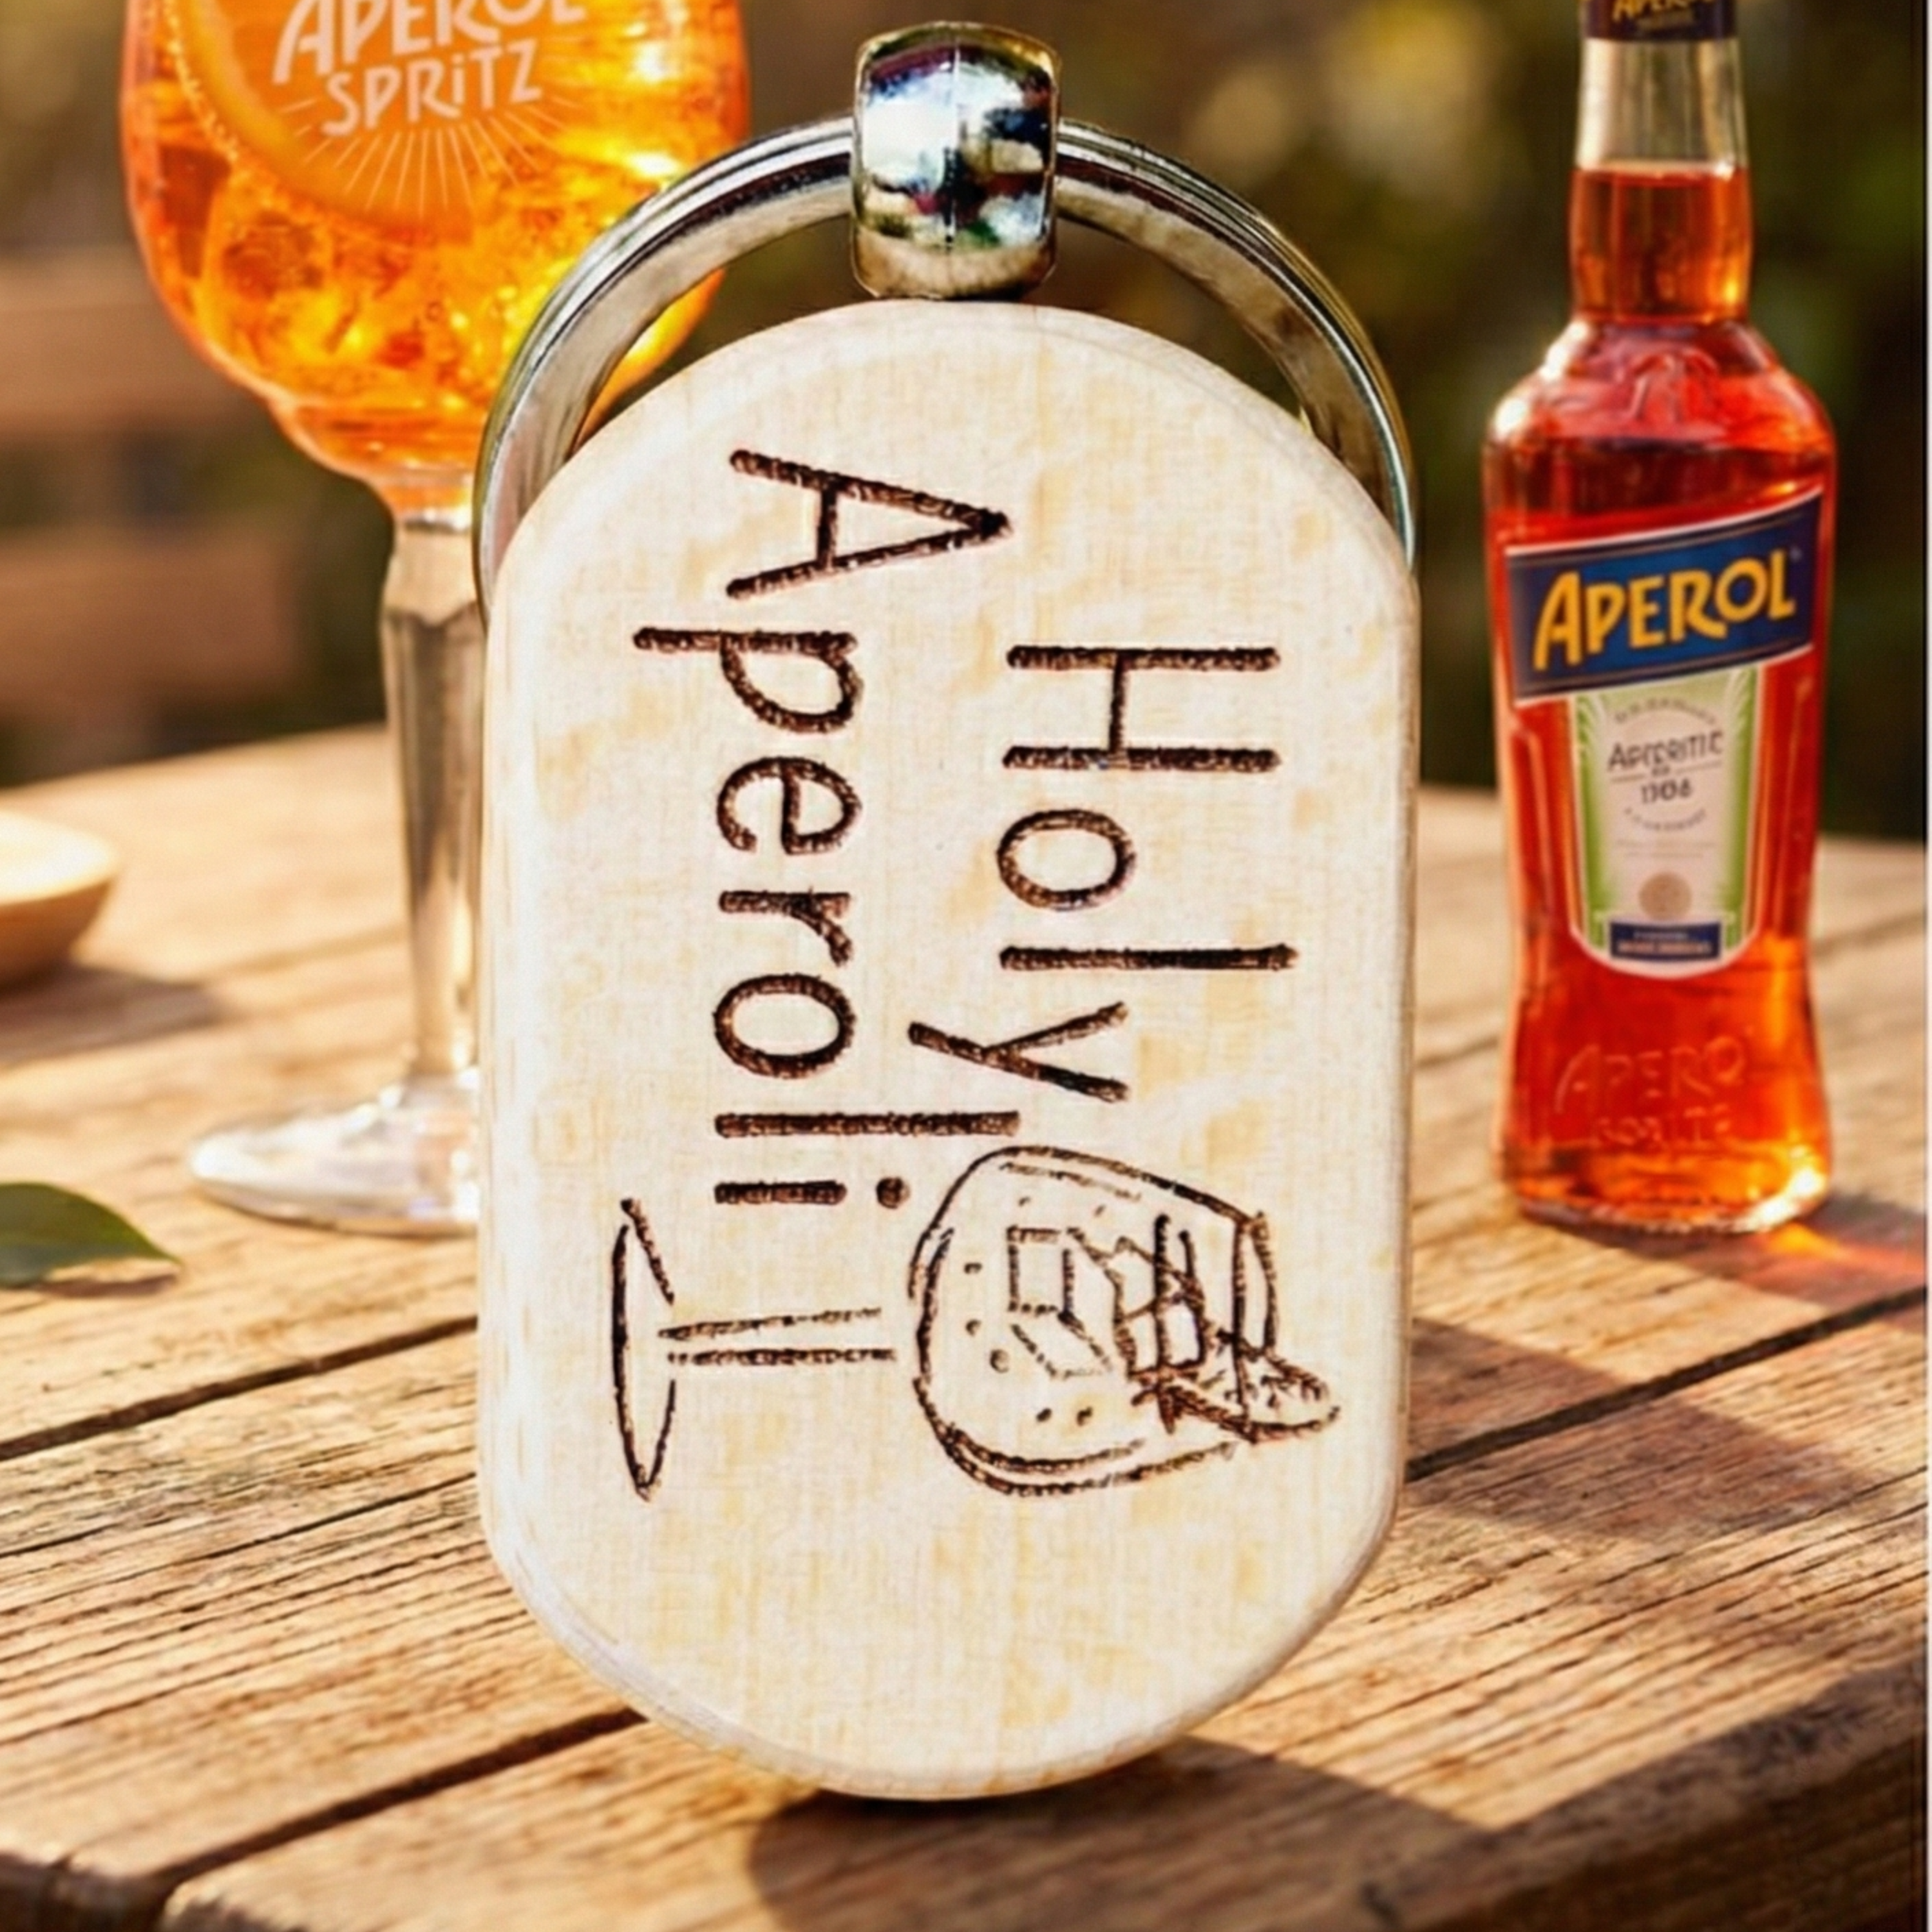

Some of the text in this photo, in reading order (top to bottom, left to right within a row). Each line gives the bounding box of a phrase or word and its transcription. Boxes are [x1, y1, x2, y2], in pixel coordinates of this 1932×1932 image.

[632, 449, 1023, 1208] Aperoli
[1533, 549, 1796, 670] APEROL
[905, 644, 1299, 1104] Holy
